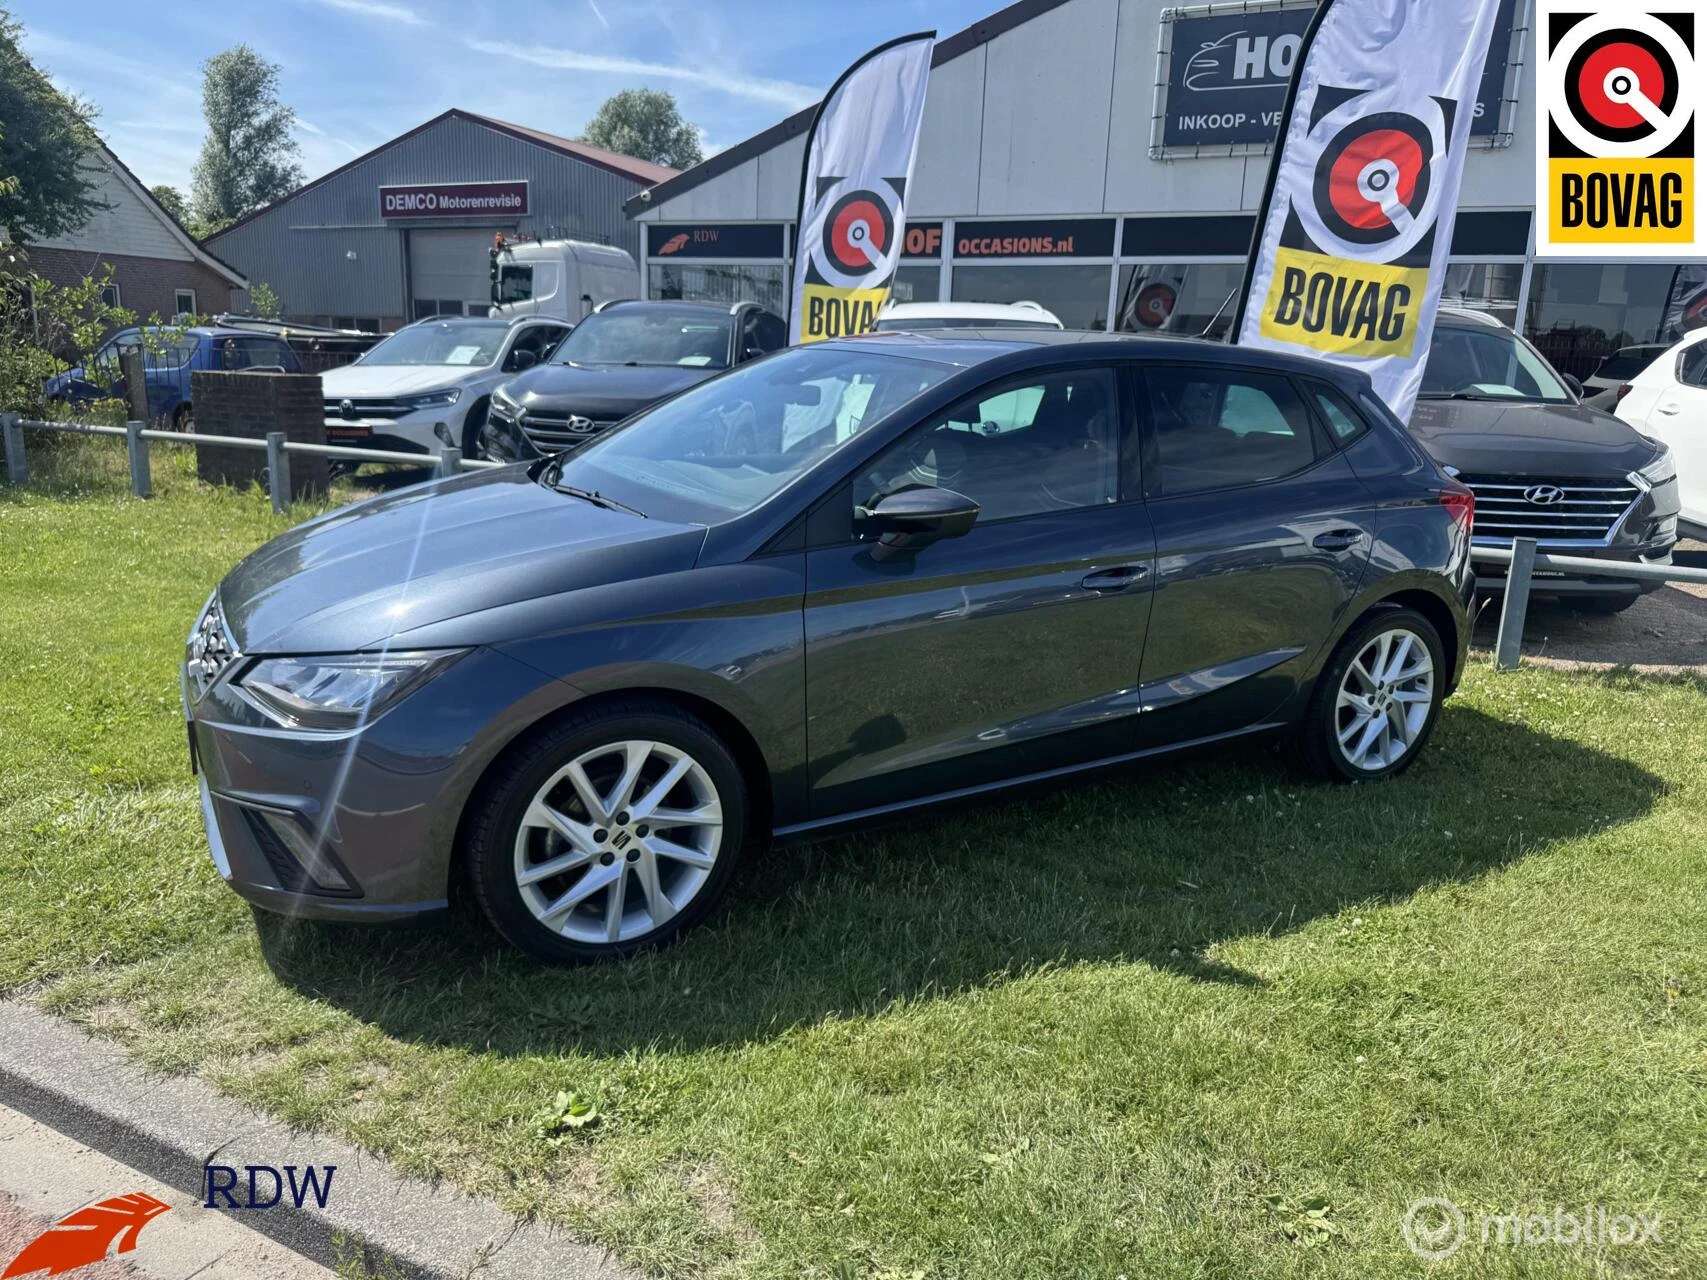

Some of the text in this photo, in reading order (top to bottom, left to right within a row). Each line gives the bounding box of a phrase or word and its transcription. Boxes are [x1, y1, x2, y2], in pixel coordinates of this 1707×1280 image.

[1233, 33, 1303, 80] HO
[1178, 113, 1246, 131] INKOOP
[385, 193, 522, 211] DEMCO Motorenrevisie
[693, 230, 720, 243] RDW
[901, 228, 1075, 255] OF OCCASIONS.nl
[808, 296, 881, 338] BOVA
[1273, 265, 1411, 342] BOVAG
